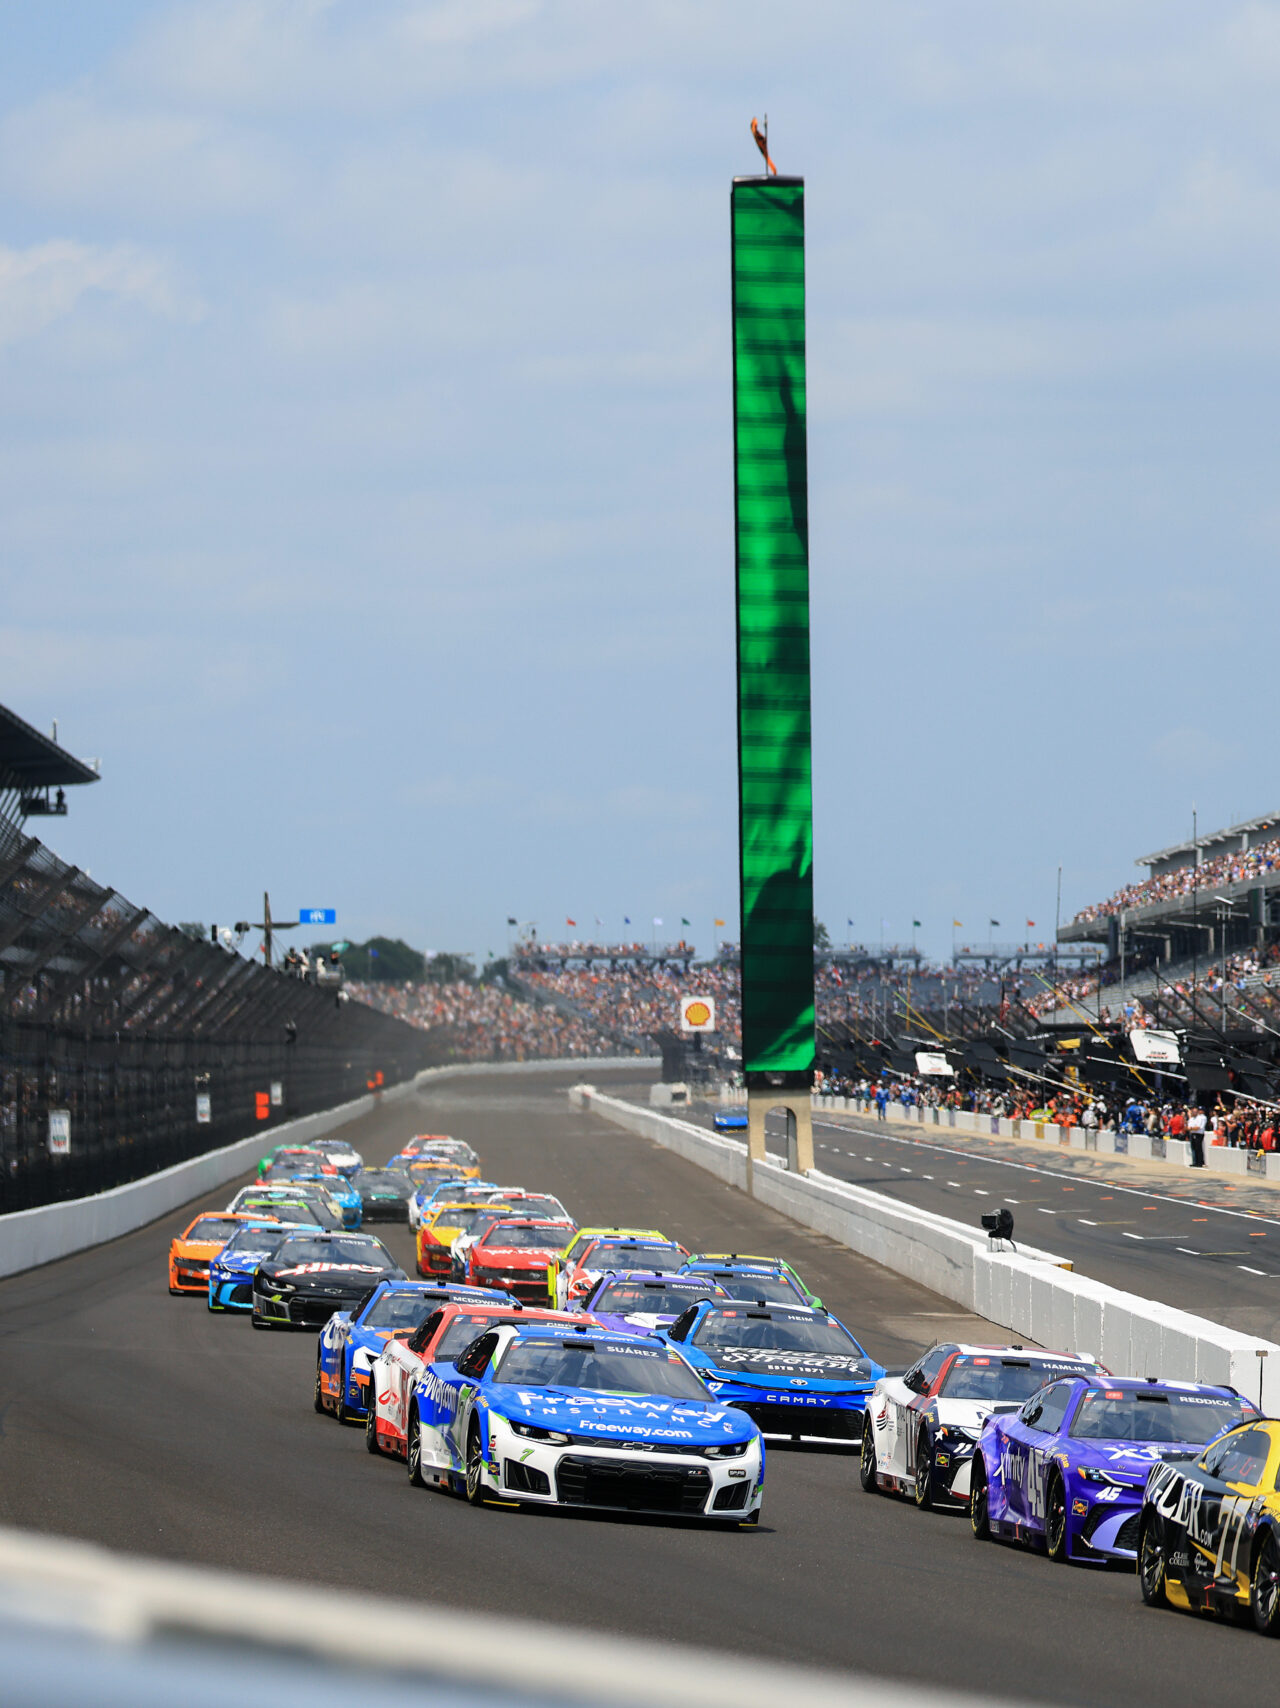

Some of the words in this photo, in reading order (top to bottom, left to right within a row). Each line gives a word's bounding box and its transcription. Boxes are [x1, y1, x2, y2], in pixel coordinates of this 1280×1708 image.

[672, 1283, 711, 1292] BOWMAN
[606, 1345, 660, 1358] SUÁREZ
[1042, 1362, 1086, 1373] HAMLIN
[766, 1394, 831, 1405] CAMRY
[1179, 1395, 1232, 1407] REDDICK
[579, 1419, 693, 1439] Freeway.com
[953, 1442, 973, 1454] 11
[519, 1448, 536, 1462] 7
[1095, 1486, 1123, 1501] 45
[1213, 1494, 1252, 1581] 77
